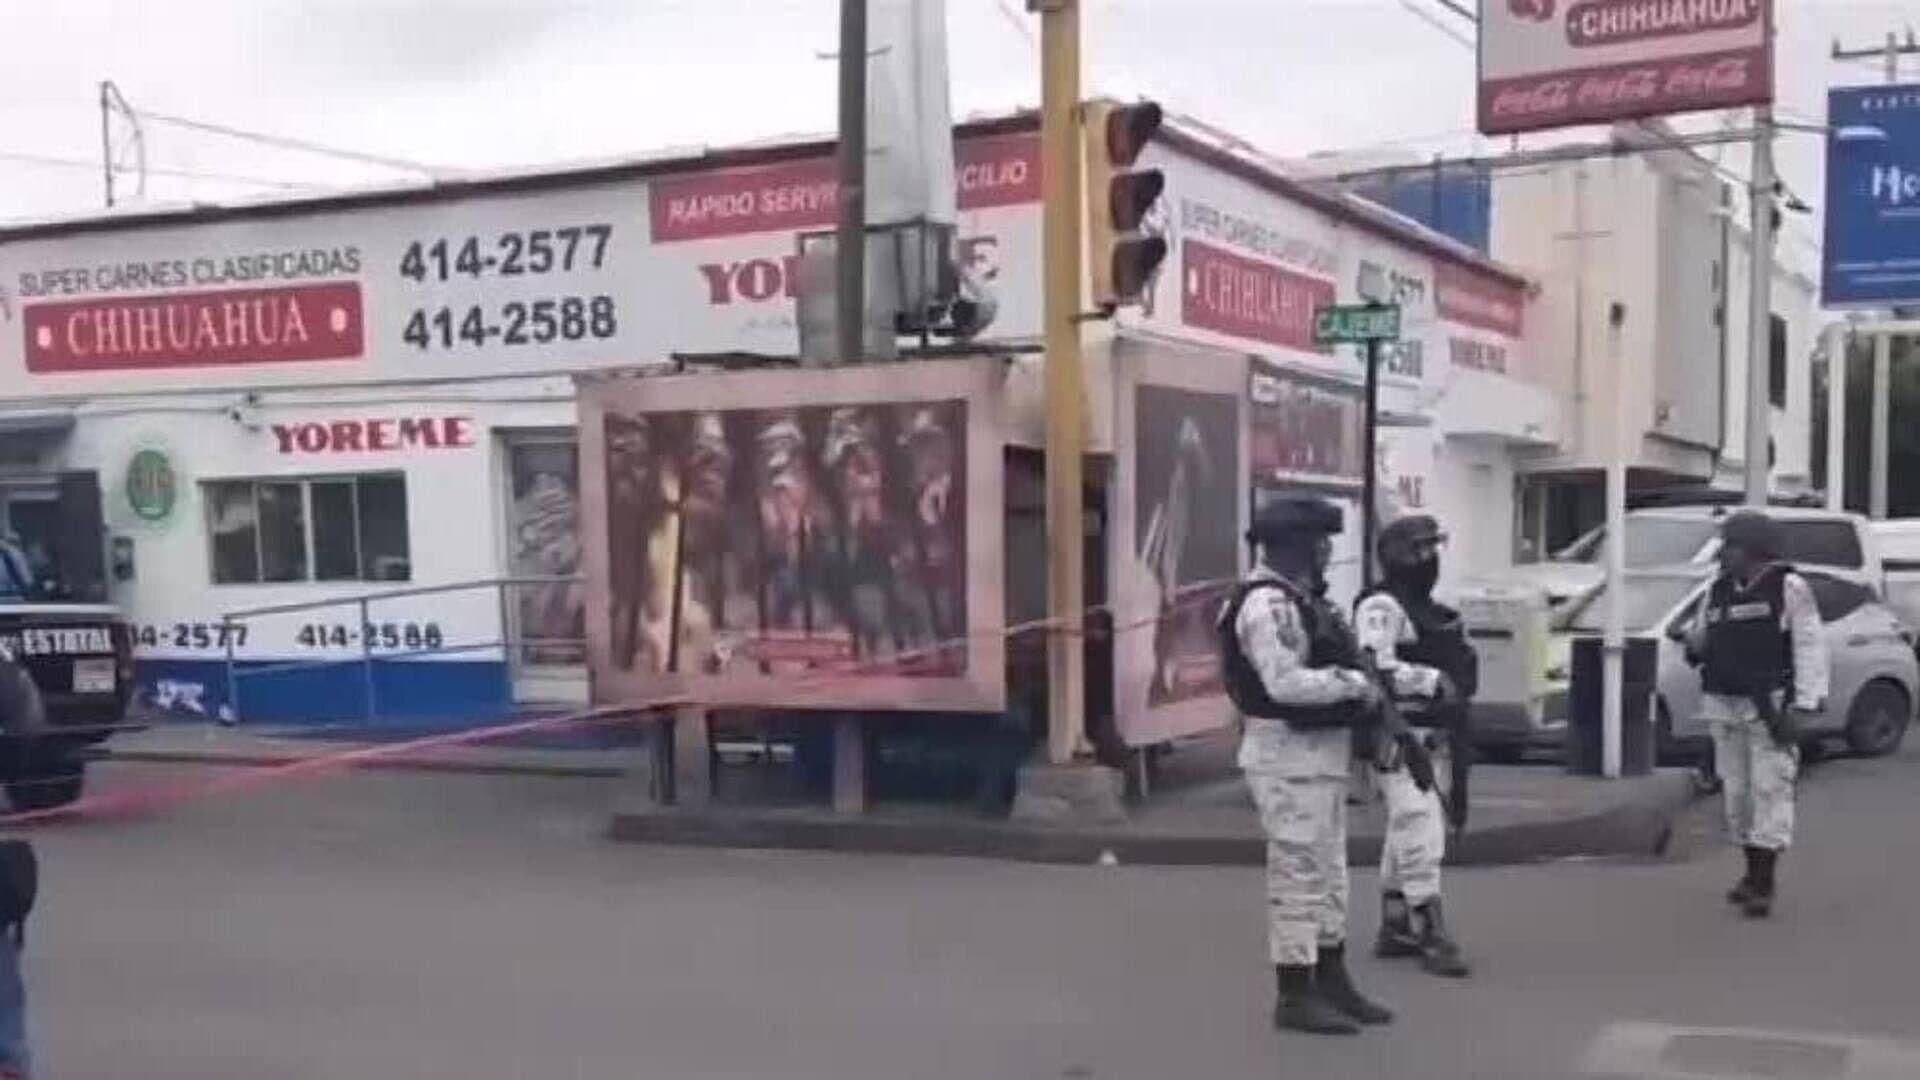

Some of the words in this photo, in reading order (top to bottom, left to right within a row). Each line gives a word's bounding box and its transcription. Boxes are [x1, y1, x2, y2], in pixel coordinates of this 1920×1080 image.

[1581, 0, 1747, 37] CHIHUAHUA
[98, 260, 187, 291] CARNES
[192, 248, 361, 283] CLASIFICADAS
[400, 224, 613, 281] 414-2577
[67, 295, 309, 355] CHIHUAHUA
[403, 296, 618, 350] 414-2588
[271, 417, 476, 453] YOREME
[296, 623, 442, 649] 414-2588
